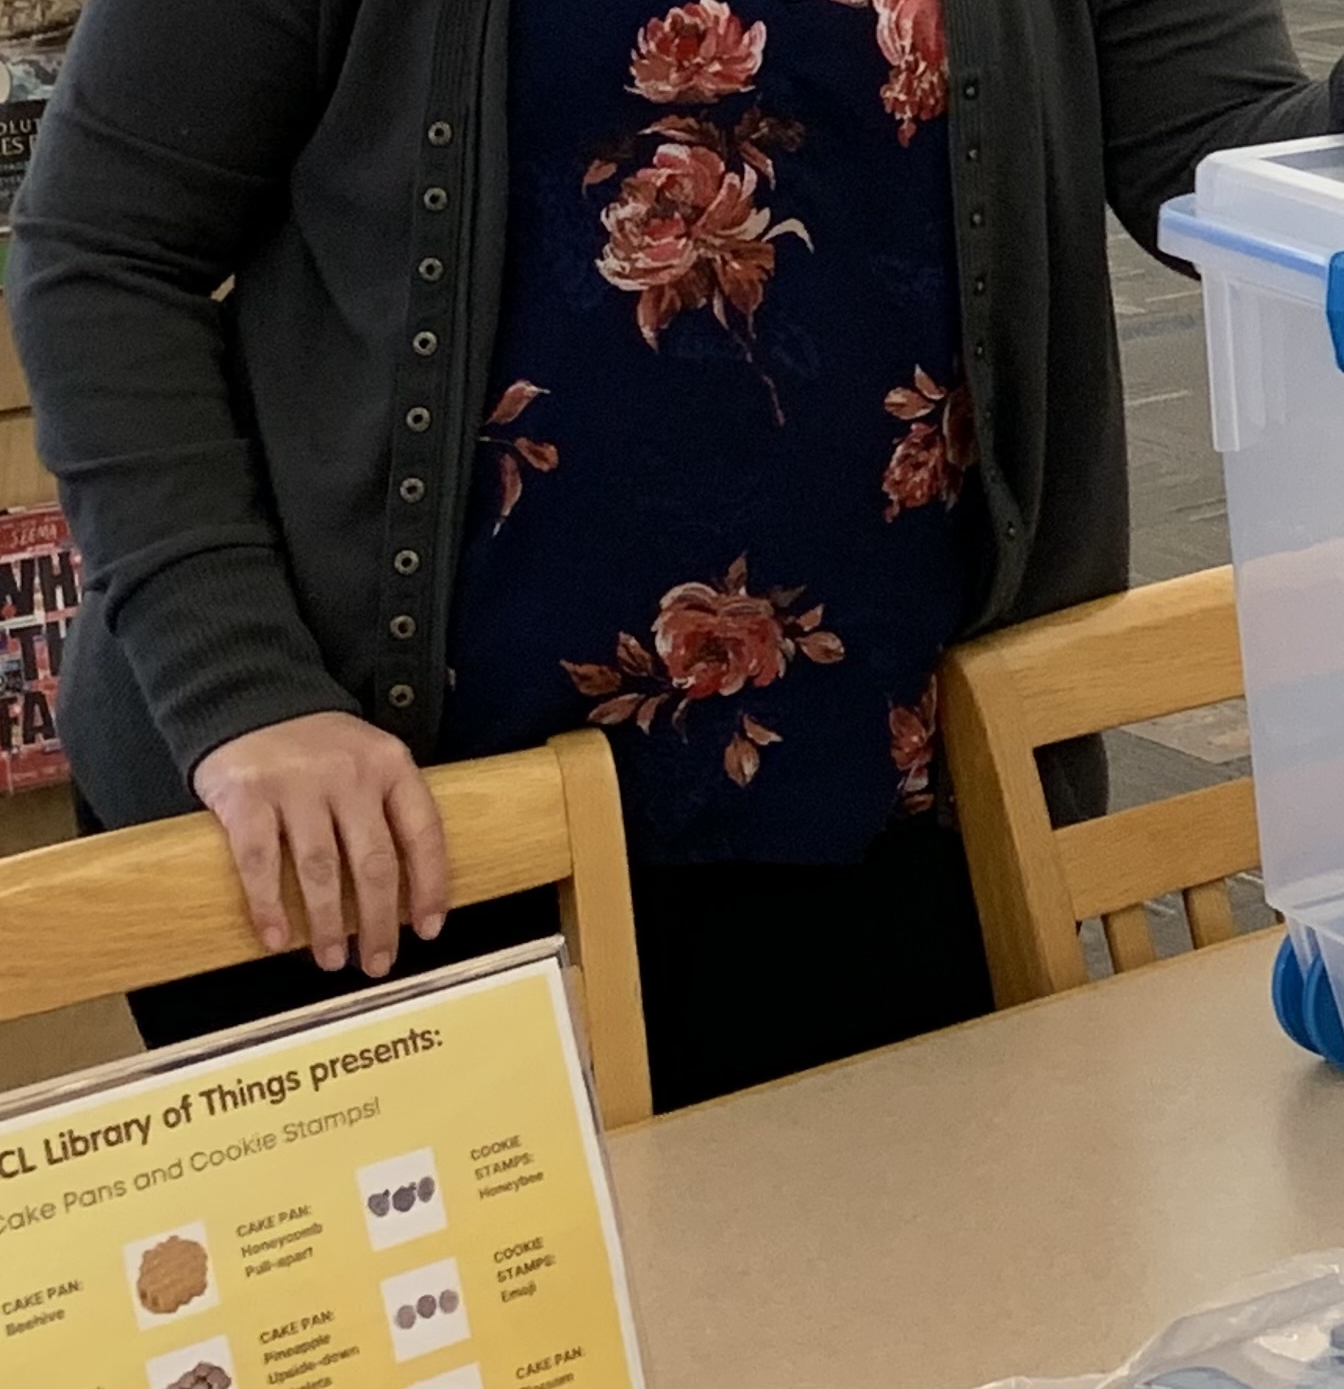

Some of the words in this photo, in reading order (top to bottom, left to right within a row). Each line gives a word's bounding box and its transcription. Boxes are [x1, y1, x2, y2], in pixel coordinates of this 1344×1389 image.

[11, 524, 57, 547] SEEMA
[43, 1115, 151, 1166] Library
[162, 1093, 193, 1129] of
[198, 1070, 301, 1116] Things
[309, 1028, 443, 1092] presents:
[63, 1180, 127, 1213] Pans
[134, 1158, 184, 1191] and
[190, 1131, 277, 1172] Cookie
[282, 1096, 381, 1143] Stamps!
[470, 1135, 521, 1160] COOKIE
[474, 1152, 534, 1180] STAMPS:
[479, 1171, 544, 1200] Honeybee
[236, 1215, 276, 1238] CAKE
[278, 1204, 312, 1224] PAN:
[241, 1222, 323, 1258] Honeycomb
[493, 1237, 544, 1264] COOKIE
[245, 1246, 313, 1277] Pull-apart
[497, 1254, 556, 1283] STAMPS:
[1, 1290, 44, 1315] CAKE
[47, 1279, 84, 1300] PAN:
[501, 1281, 537, 1303] Emoji
[6, 1309, 65, 1337] Beehive
[259, 1321, 298, 1344] CAKE
[301, 1310, 335, 1330] PAN:
[264, 1334, 331, 1365] Pineapple
[516, 1357, 552, 1380] CAKE
[555, 1346, 585, 1367] PAN:
[268, 1346, 360, 1385] Upside-down
